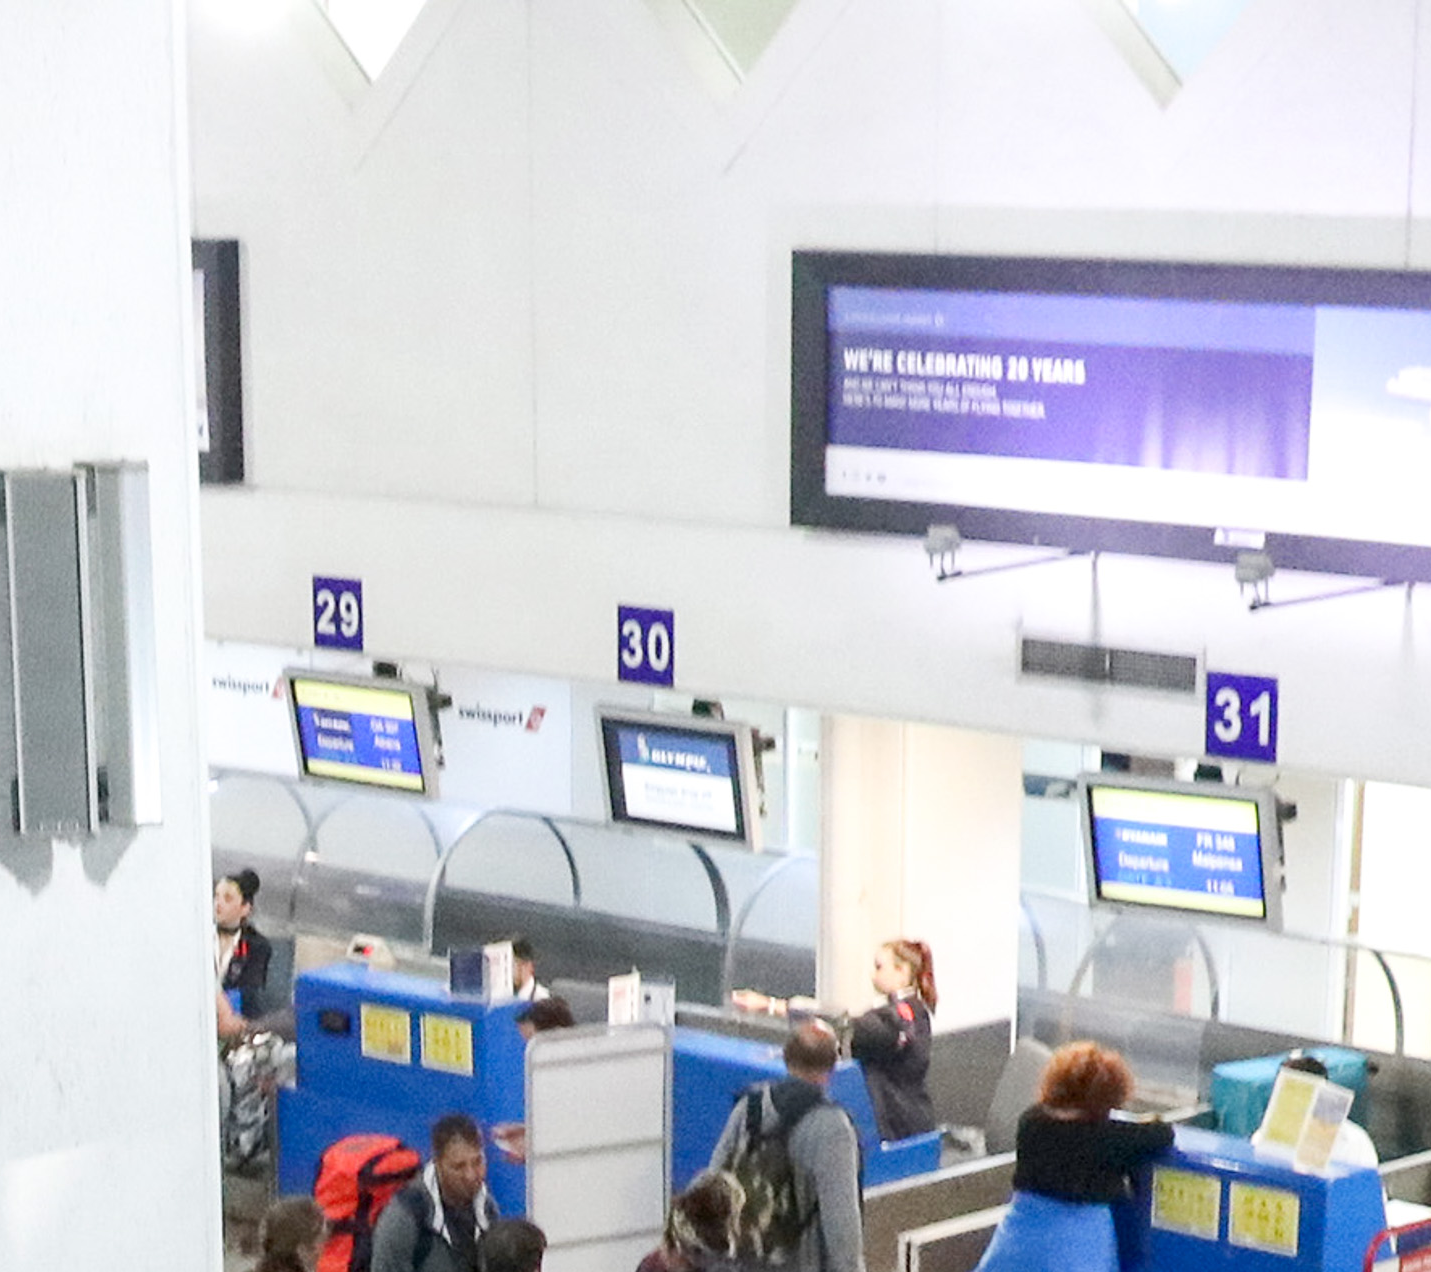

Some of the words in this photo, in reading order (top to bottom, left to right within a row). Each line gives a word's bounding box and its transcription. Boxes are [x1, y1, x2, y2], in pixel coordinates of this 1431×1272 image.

[843, 347, 893, 374] WE'RE
[897, 350, 1003, 381] CELEBRATING
[1006, 354, 1030, 382] 20
[1032, 357, 1086, 386] YEARS
[316, 590, 360, 638] 29
[621, 620, 670, 672] 30
[459, 703, 522, 728] swissport
[1213, 688, 1273, 747] 31
